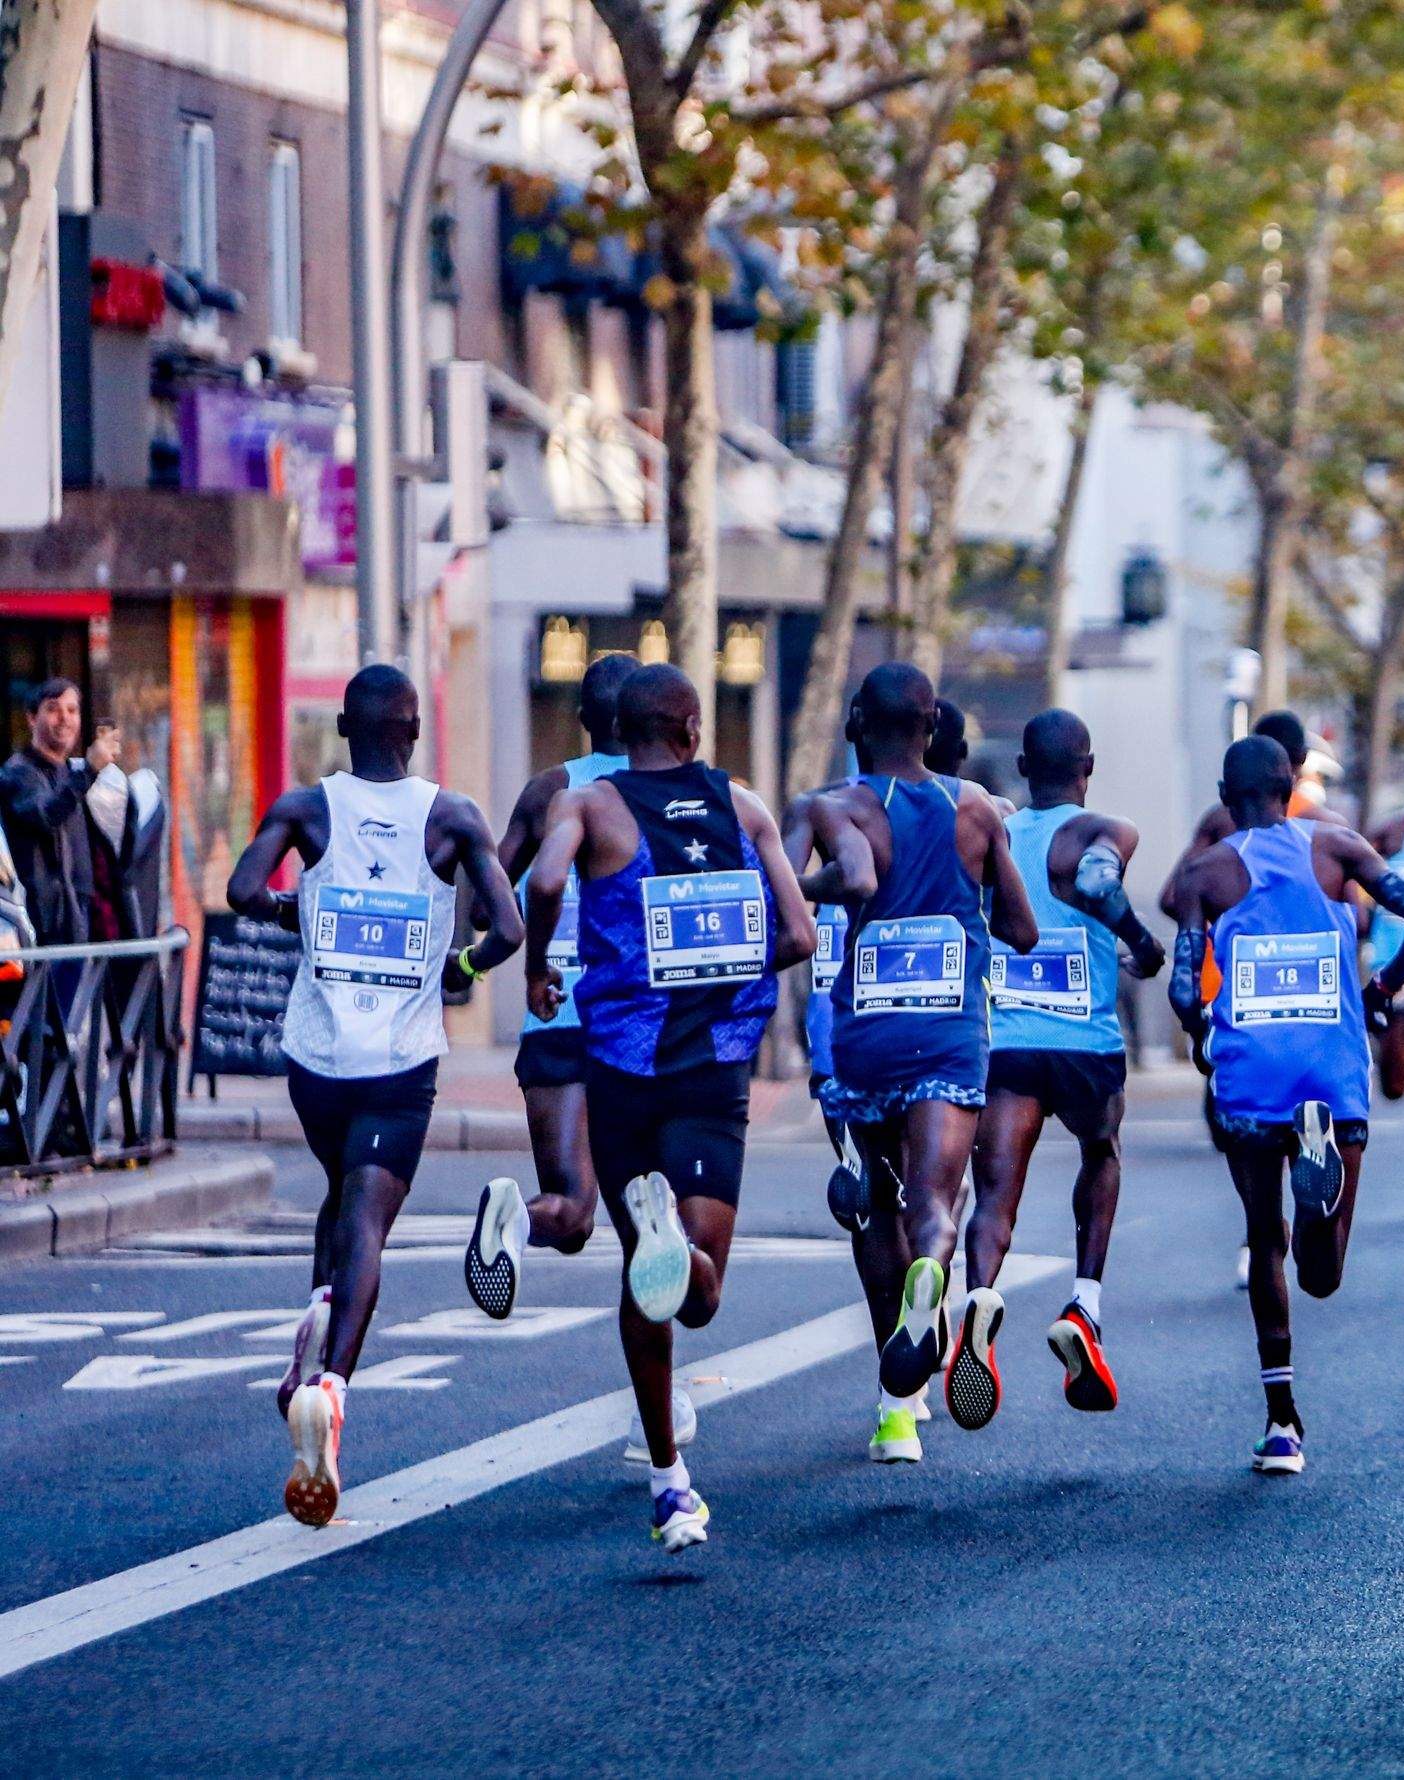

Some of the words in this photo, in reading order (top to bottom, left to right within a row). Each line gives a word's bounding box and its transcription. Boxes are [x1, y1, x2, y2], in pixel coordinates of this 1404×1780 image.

[695, 912, 722, 932] 16
[904, 925, 942, 937] Movistar
[359, 923, 384, 943] 10
[904, 952, 916, 970] 7
[1032, 962, 1043, 980] 9
[1276, 968, 1298, 985] 18
